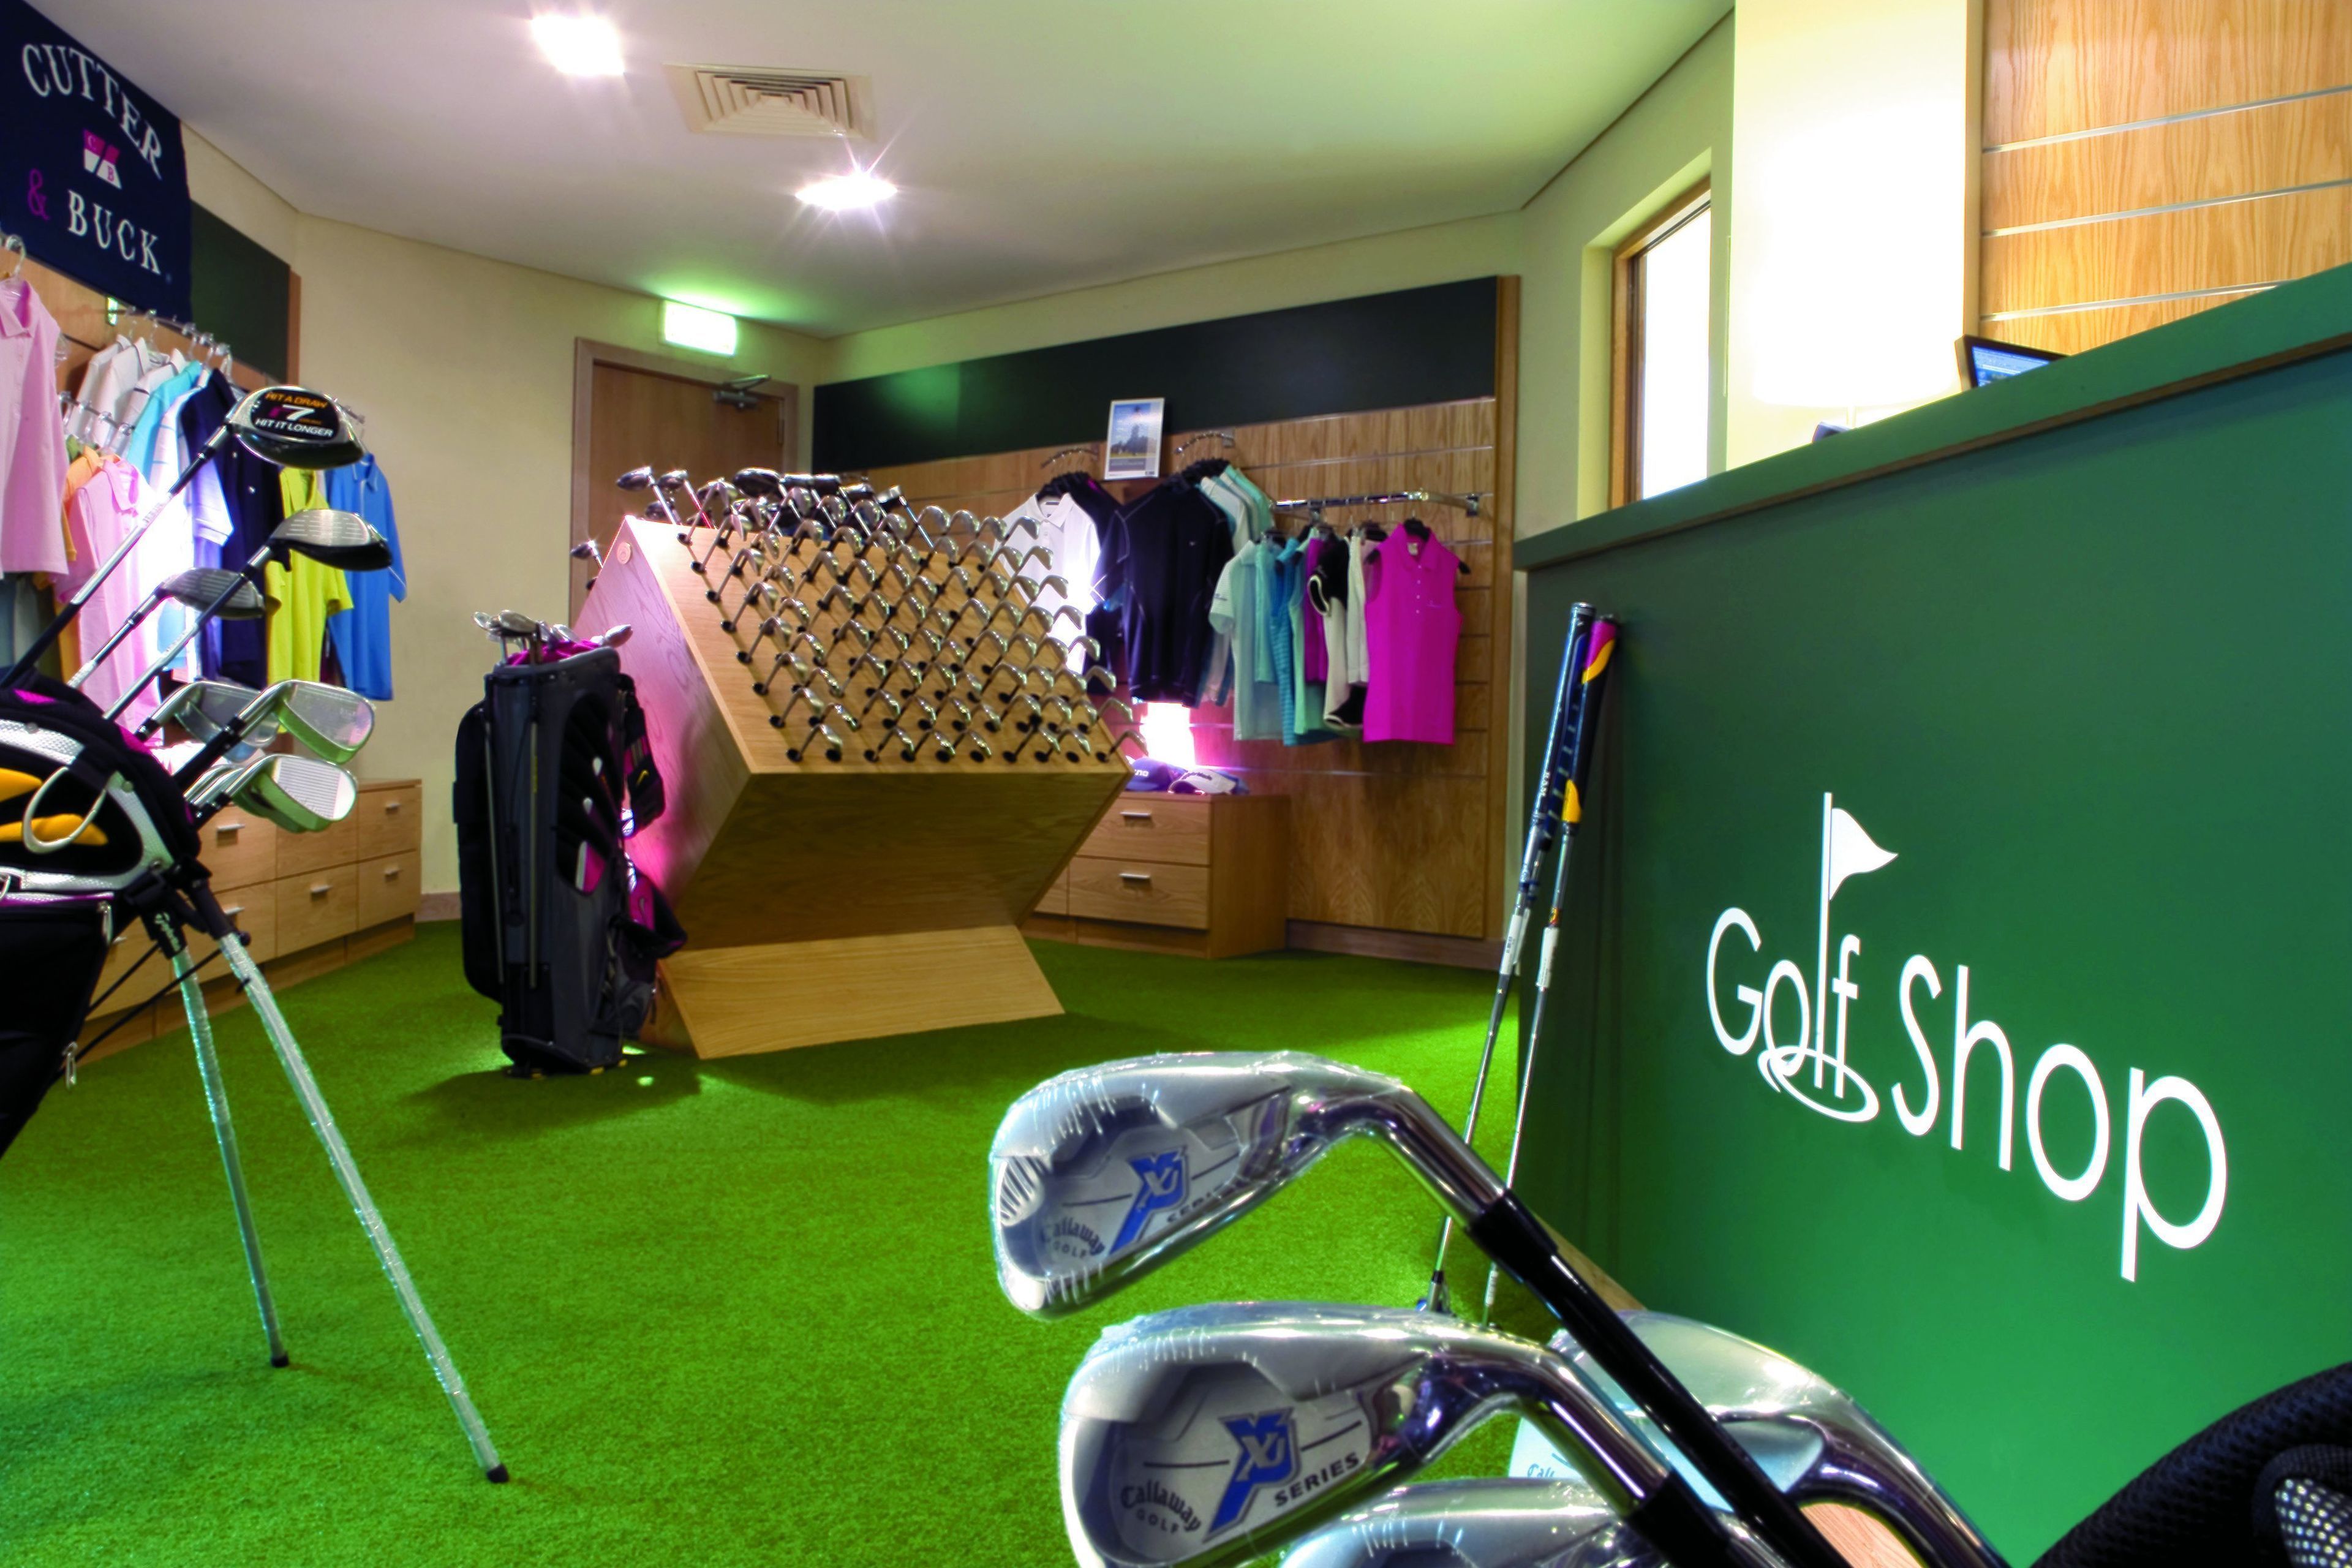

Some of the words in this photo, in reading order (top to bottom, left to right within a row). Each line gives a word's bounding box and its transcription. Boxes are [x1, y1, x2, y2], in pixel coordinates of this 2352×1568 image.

[23, 43, 162, 181] CUTTER
[28, 168, 50, 221] &
[68, 189, 161, 274] BUCK
[255, 418, 275, 427] HIT
[275, 420, 287, 429] IT
[288, 422, 334, 437] LONGER
[1706, 793, 1862, 1098] Golf
[1891, 954, 2227, 1283] Shop
[1039, 1216, 1106, 1256] Callaway
[1120, 1479, 1201, 1532] Callaway
[1274, 1451, 1360, 1507] SERIES
[1136, 1508, 1180, 1535] GOLF
